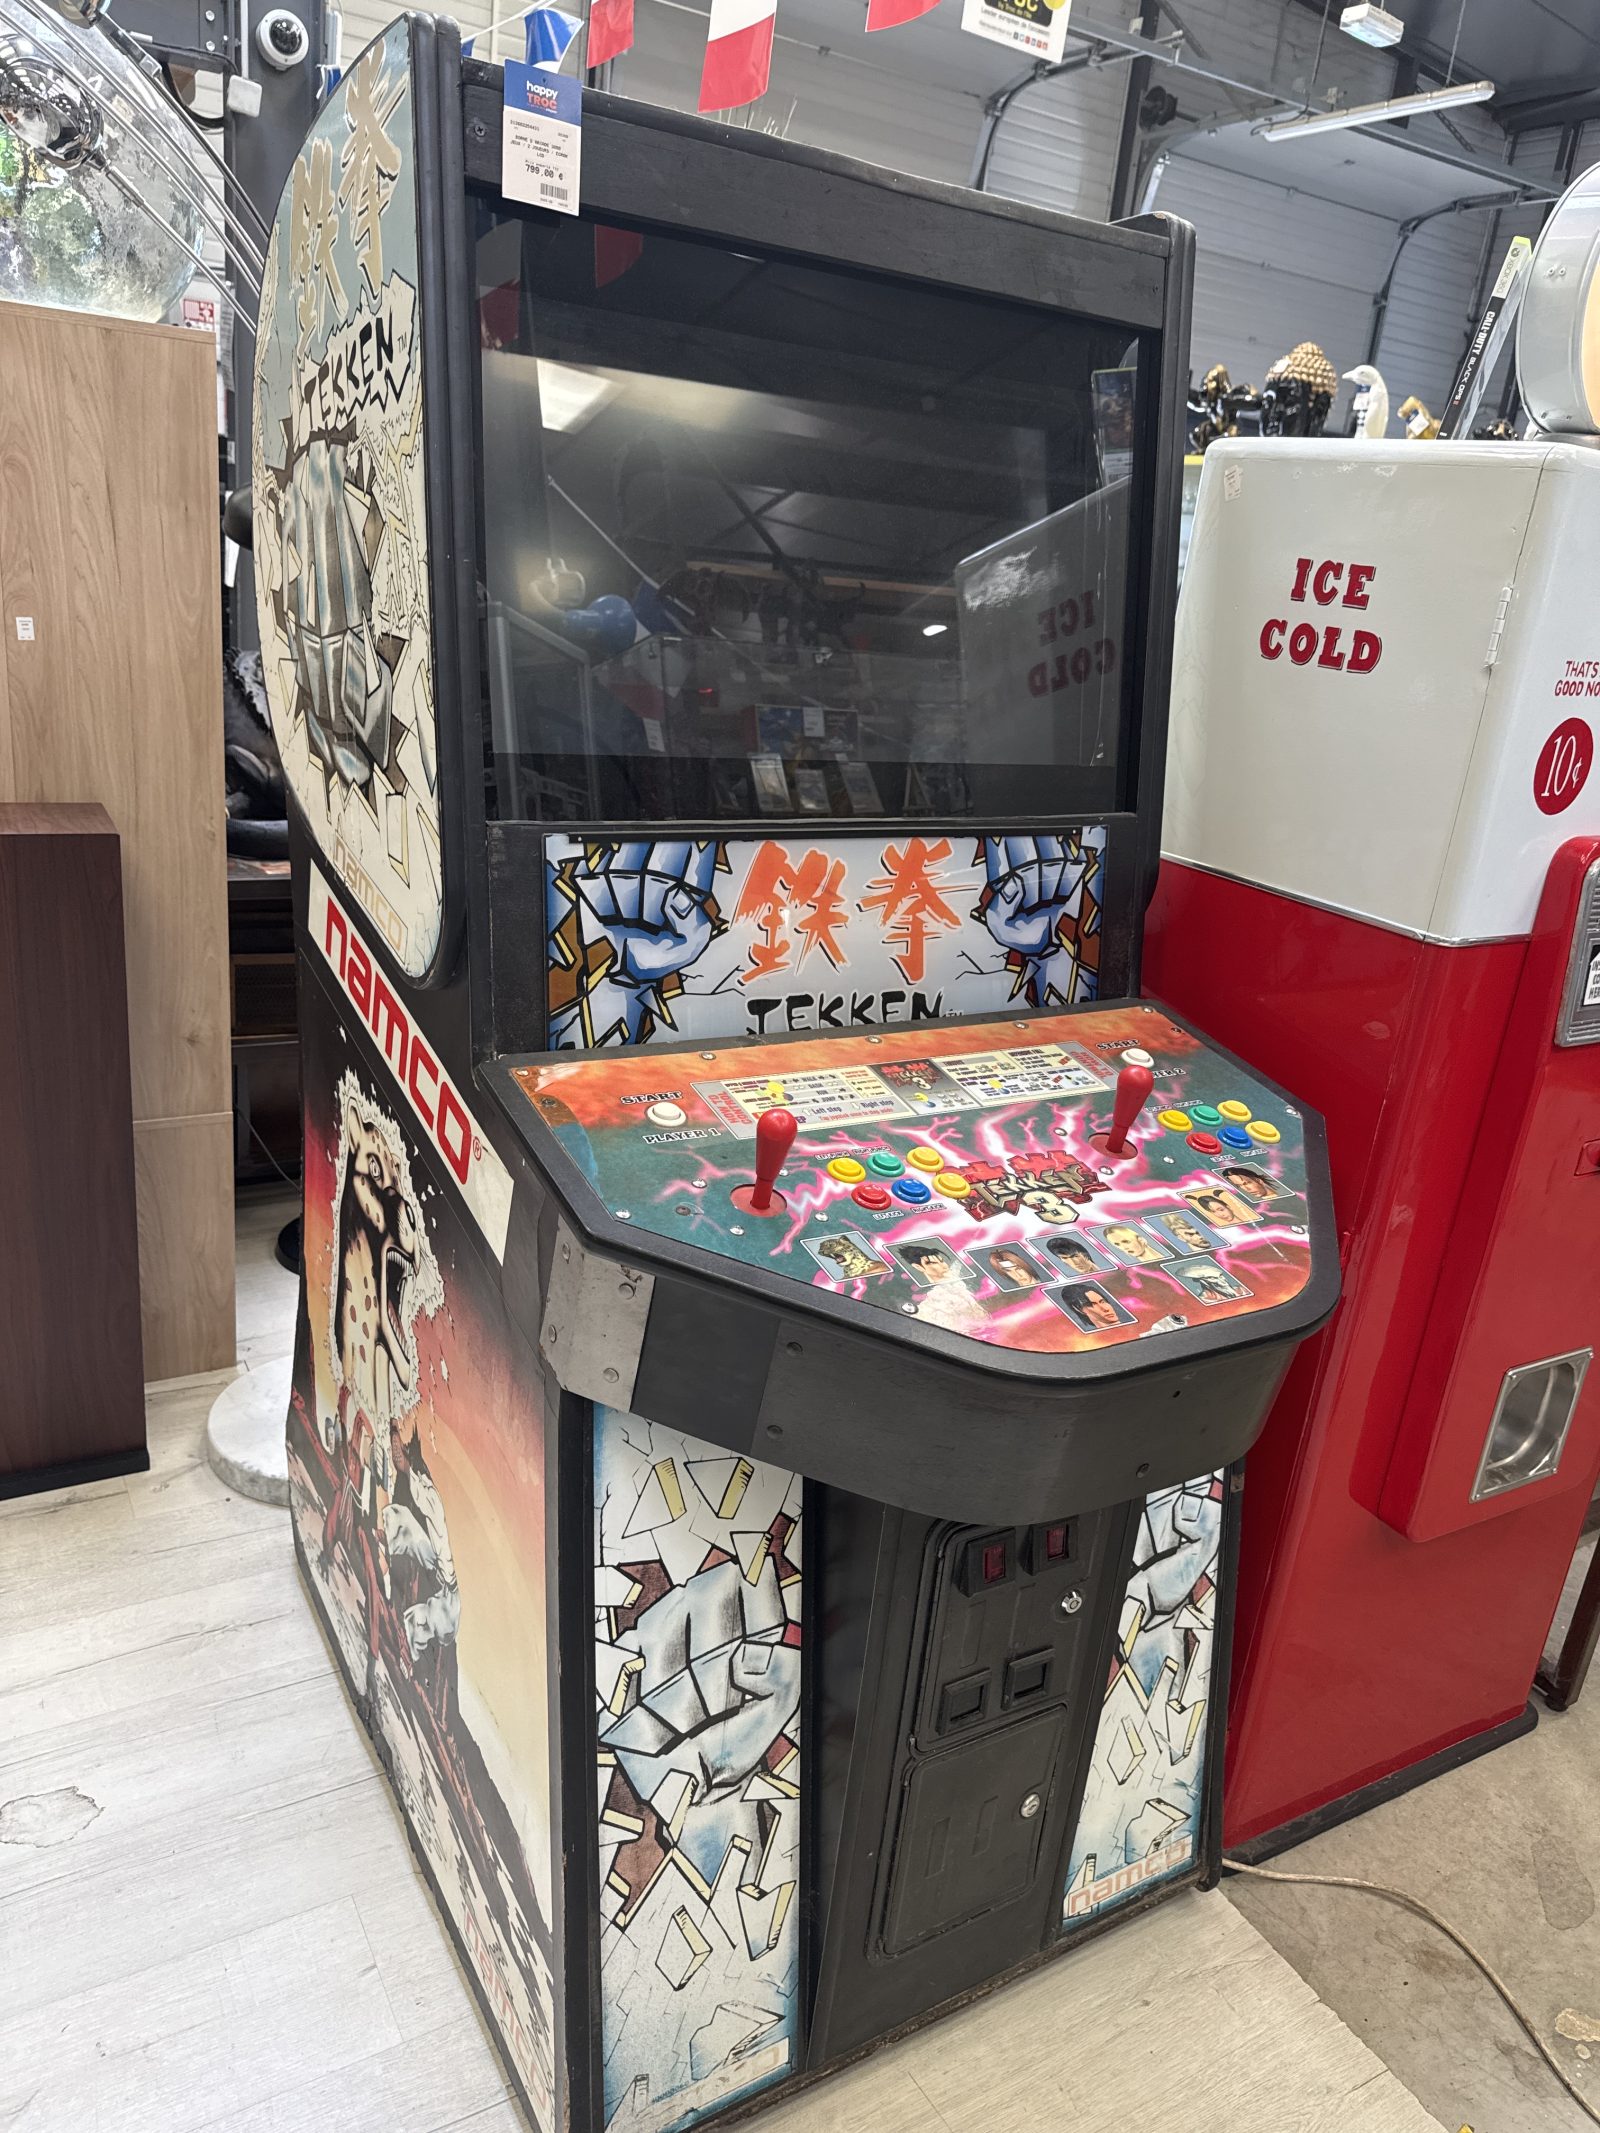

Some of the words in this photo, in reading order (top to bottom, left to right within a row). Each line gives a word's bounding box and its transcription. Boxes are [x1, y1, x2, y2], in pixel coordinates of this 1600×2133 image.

[526, 80, 558, 100] happy
[526, 92, 557, 109] TROC
[559, 172, 564, 181] €
[304, 305, 394, 430] TEKKEN
[1461, 356, 1477, 383] BLACK
[1455, 384, 1465, 400] OPS
[1290, 558, 1377, 610] ICE
[1260, 618, 1382, 674] COLD
[1554, 680, 1585, 697] GOOD
[1585, 681, 1600, 697] NO
[335, 836, 402, 951] namco
[746, 988, 942, 1035] TEKKEN
[325, 895, 472, 1182] namco
[1096, 1039, 1140, 1051] START
[1176, 1067, 1186, 1076] 2
[620, 1091, 682, 1105] START
[860, 1101, 879, 1109] Right
[879, 1099, 895, 1107] step
[811, 1107, 826, 1115] Left
[826, 1106, 842, 1114] step
[643, 1129, 708, 1145] PLAYER
[708, 1127, 721, 1137] 1
[969, 1163, 1085, 1209] TEKKEN
[1021, 1190, 1079, 1225] 3
[1070, 1840, 1186, 1914] namco
